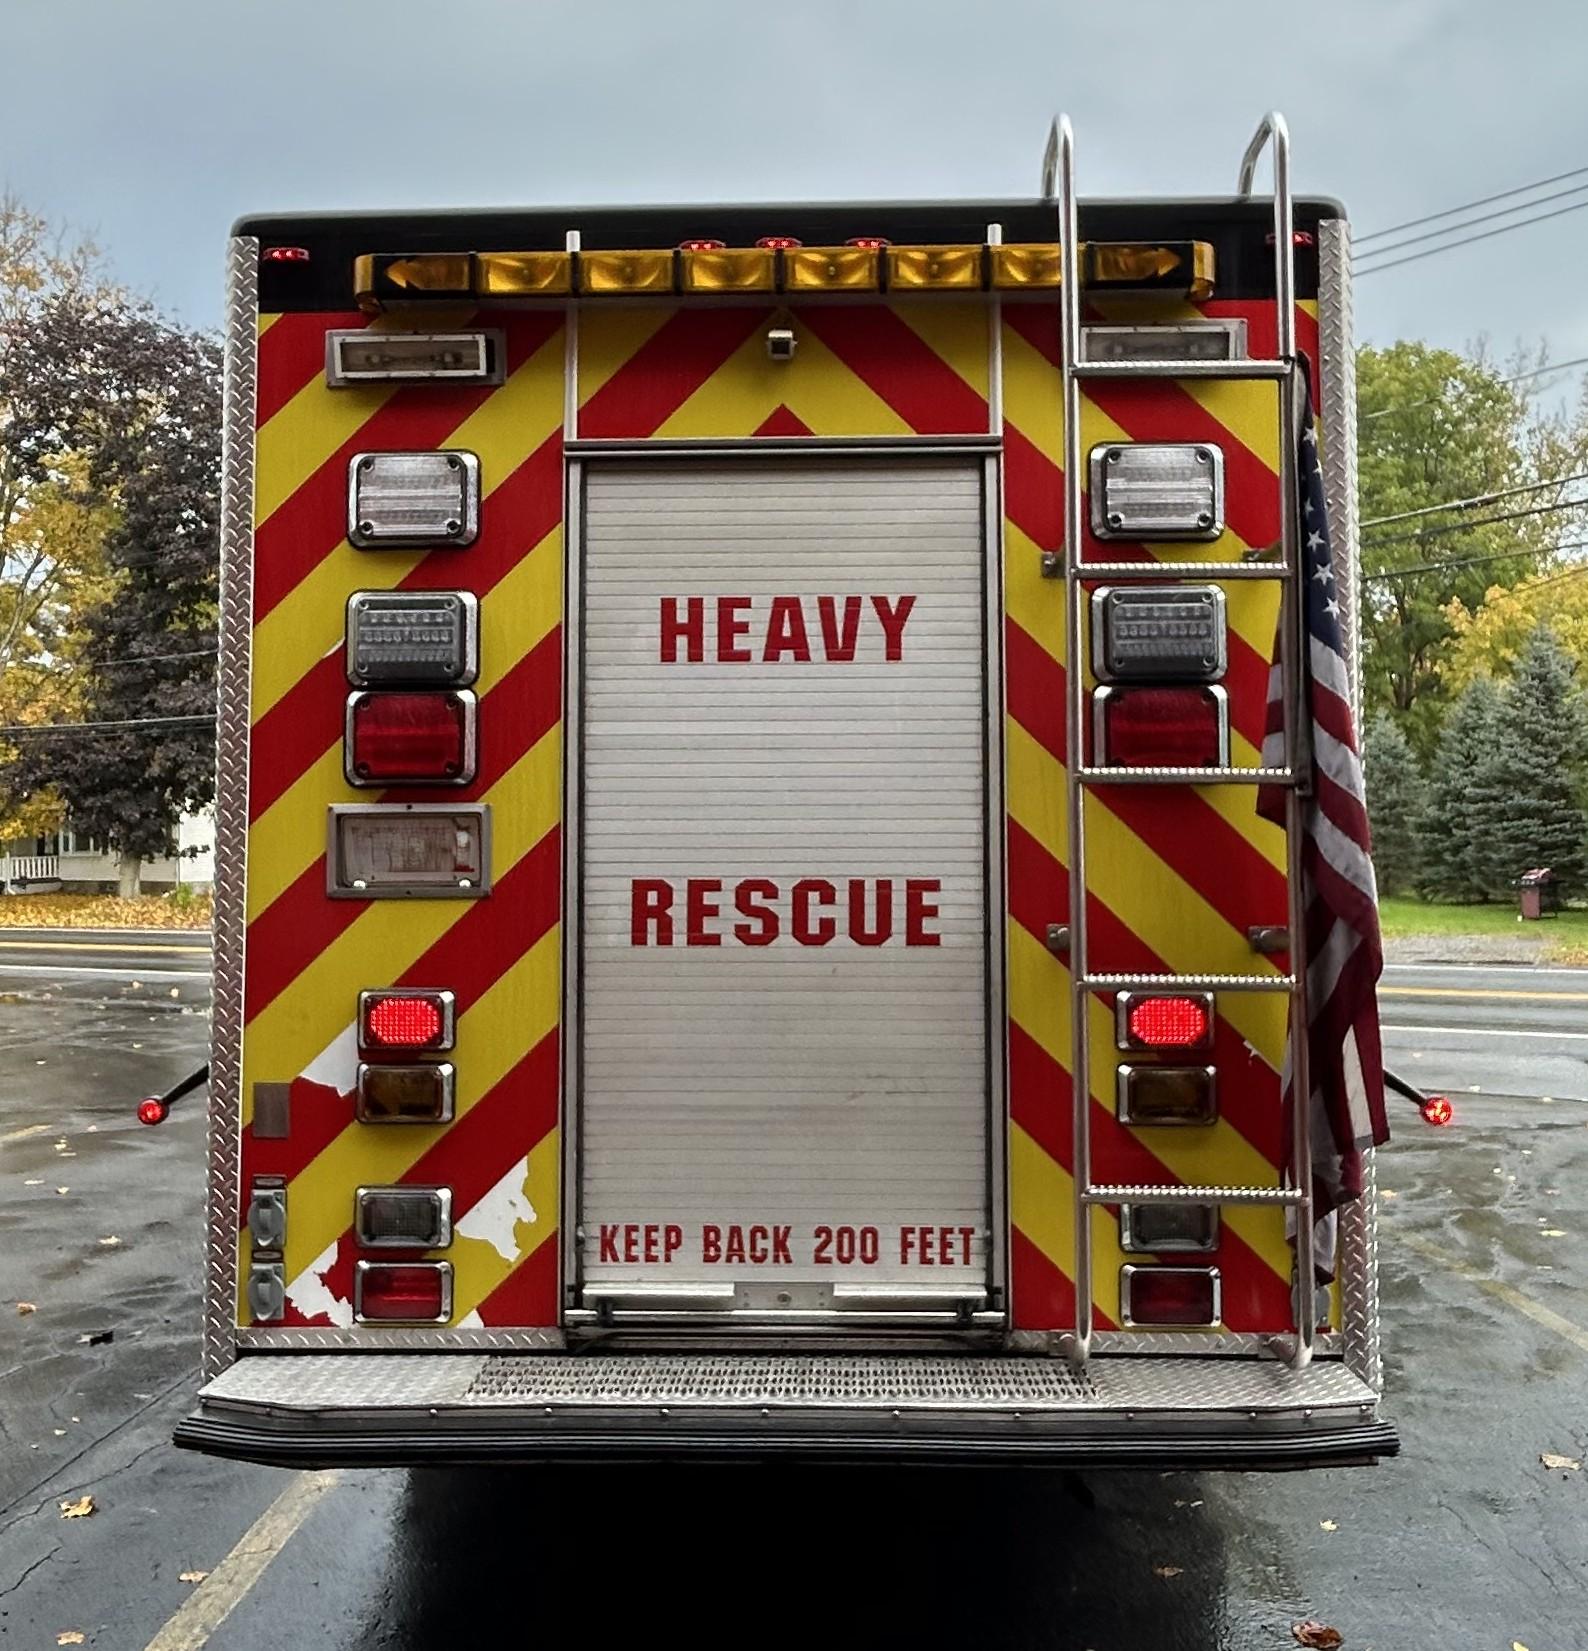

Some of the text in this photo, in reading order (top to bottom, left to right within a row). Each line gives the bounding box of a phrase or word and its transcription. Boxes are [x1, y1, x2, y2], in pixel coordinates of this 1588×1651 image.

[660, 595, 917, 663] HEAVY
[631, 879, 941, 946] RESCUE
[599, 1224, 976, 1266] KEEP BACK 200 FEET
